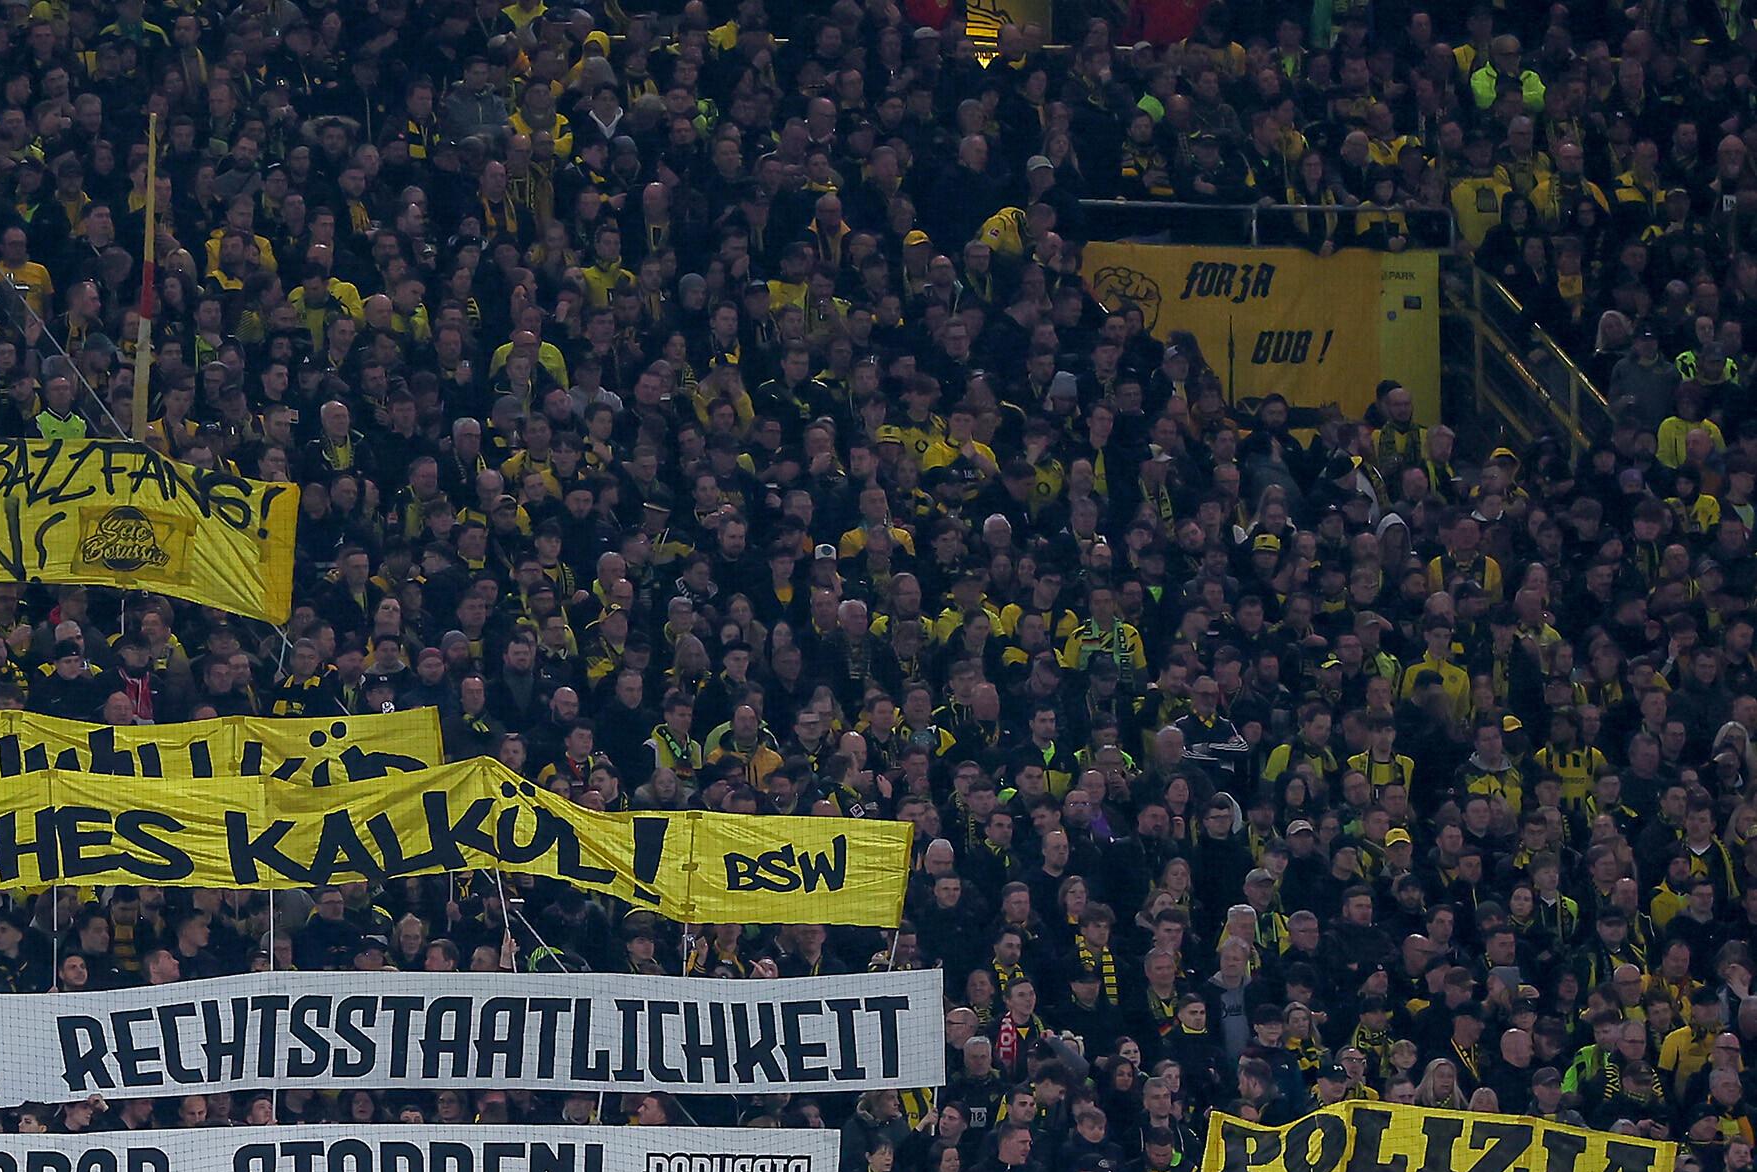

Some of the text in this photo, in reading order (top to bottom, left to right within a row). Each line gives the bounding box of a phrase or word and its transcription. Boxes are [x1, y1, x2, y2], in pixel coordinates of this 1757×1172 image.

[224, 781, 669, 902] KALKÜL!
[723, 834, 847, 893] BSW
[56, 995, 909, 1091] RECHTSSTAATLICHKEIT
